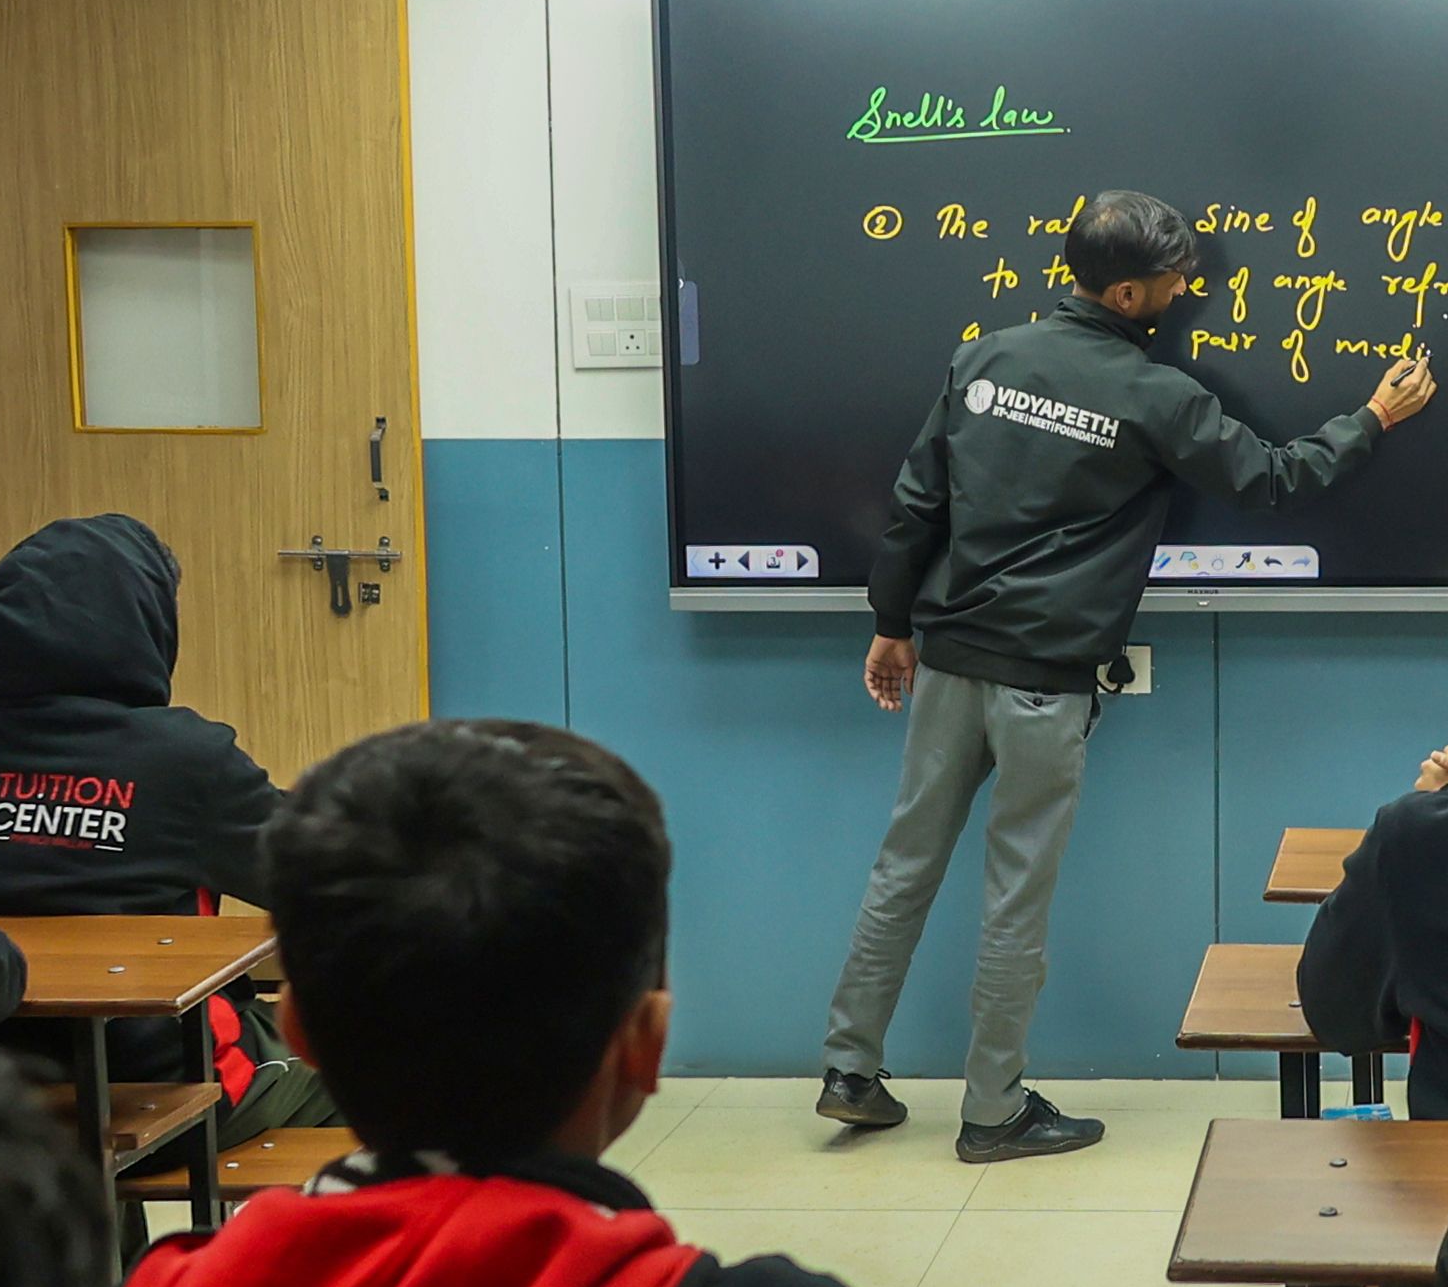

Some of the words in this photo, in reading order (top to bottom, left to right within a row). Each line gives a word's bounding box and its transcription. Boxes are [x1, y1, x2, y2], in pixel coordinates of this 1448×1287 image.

[937, 203, 989, 239] The
[1028, 195, 1087, 235] rat
[1293, 197, 1316, 257] of
[1362, 201, 1444, 262] angle
[983, 258, 1019, 299] to
[1042, 255, 1075, 289] th
[1229, 267, 1250, 323] of
[1273, 271, 1348, 330] angle
[1282, 329, 1309, 382] of
[997, 386, 1119, 437] VIDYAPEETH
[0, 773, 135, 808] TUITION
